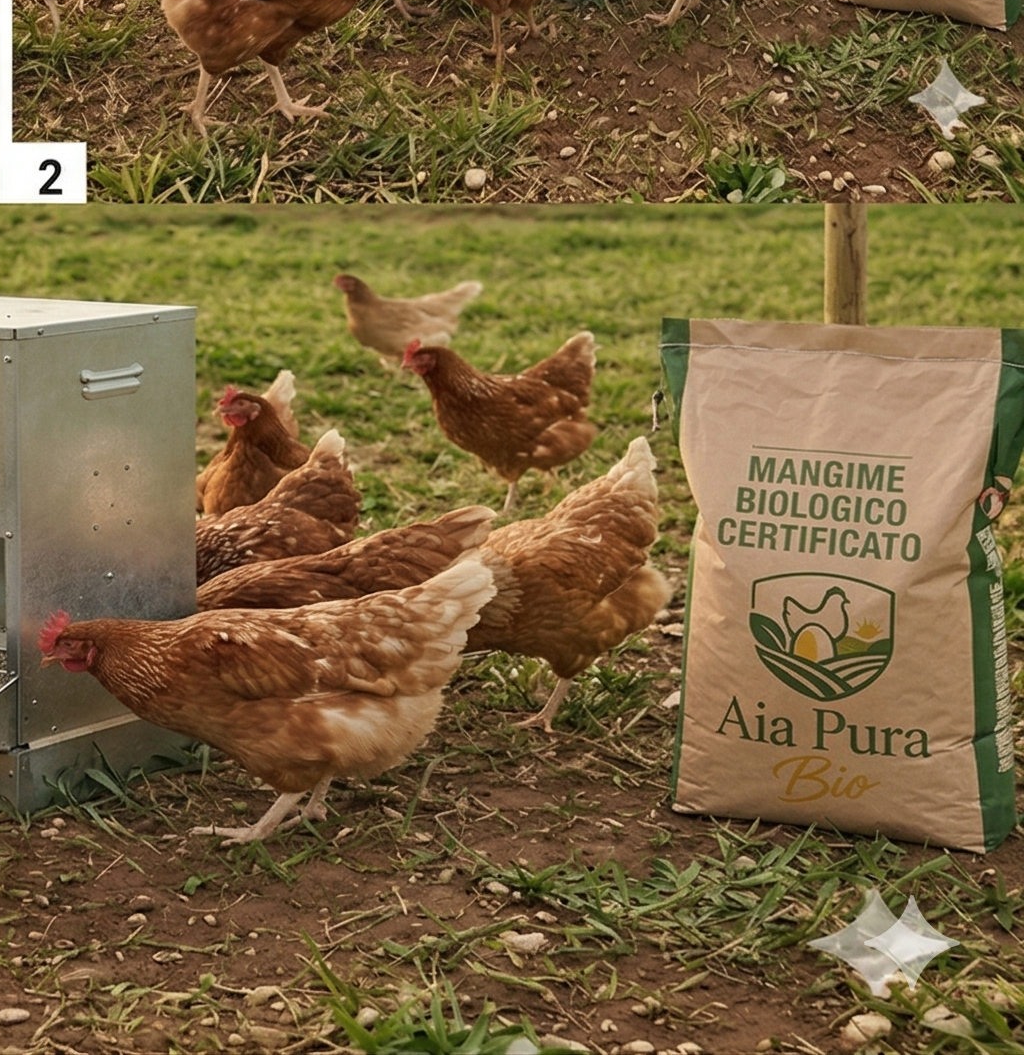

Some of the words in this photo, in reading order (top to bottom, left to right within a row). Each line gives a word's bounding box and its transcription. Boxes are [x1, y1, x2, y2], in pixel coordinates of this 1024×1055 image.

[748, 456, 906, 493] MANGIME
[736, 487, 907, 527] BIOLOGICO
[717, 518, 921, 562] CERTIFICATO
[716, 696, 796, 748] Aia
[812, 709, 932, 758] Pura
[772, 756, 881, 803] Bio
